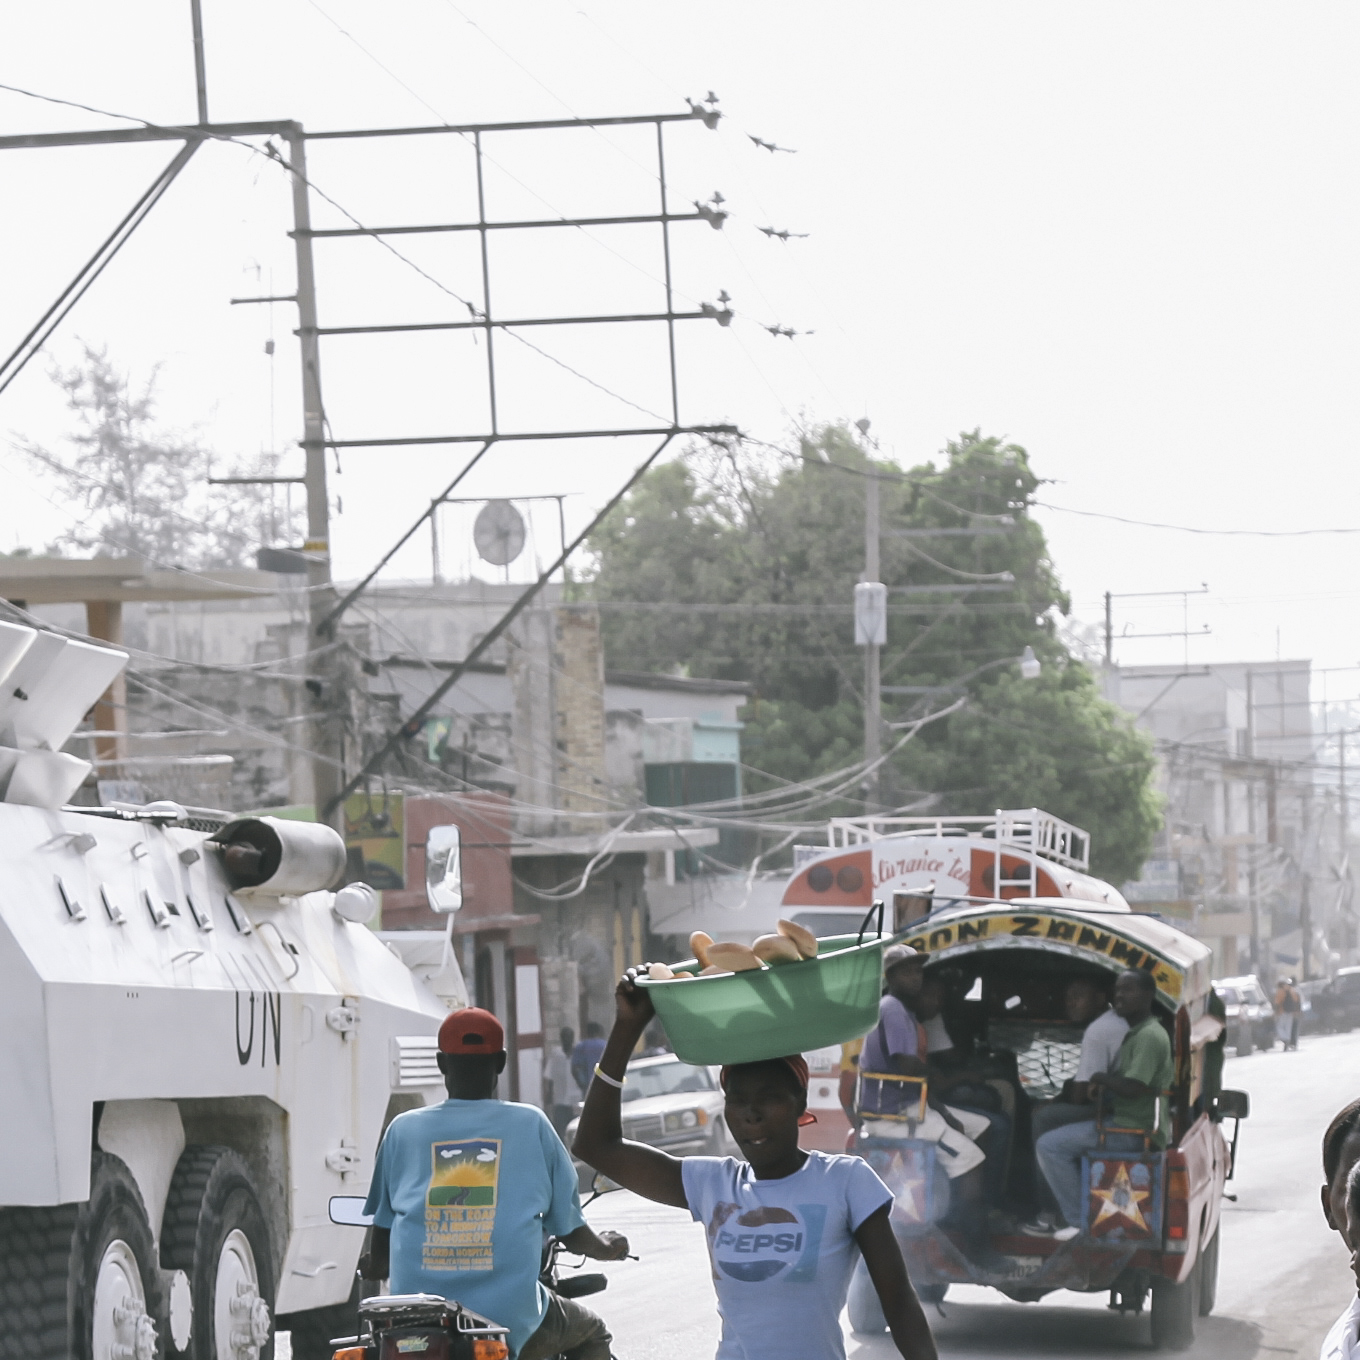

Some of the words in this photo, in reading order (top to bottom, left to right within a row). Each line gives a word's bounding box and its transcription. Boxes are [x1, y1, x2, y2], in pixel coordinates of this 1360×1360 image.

[236, 990, 281, 1068] UN
[425, 1209, 441, 1221] ON
[443, 1209, 464, 1221] THE
[425, 1221, 439, 1232] TO
[441, 1221, 449, 1232] A
[426, 1231, 492, 1243] TOMORROW
[715, 1230, 803, 1254] PEPSI
